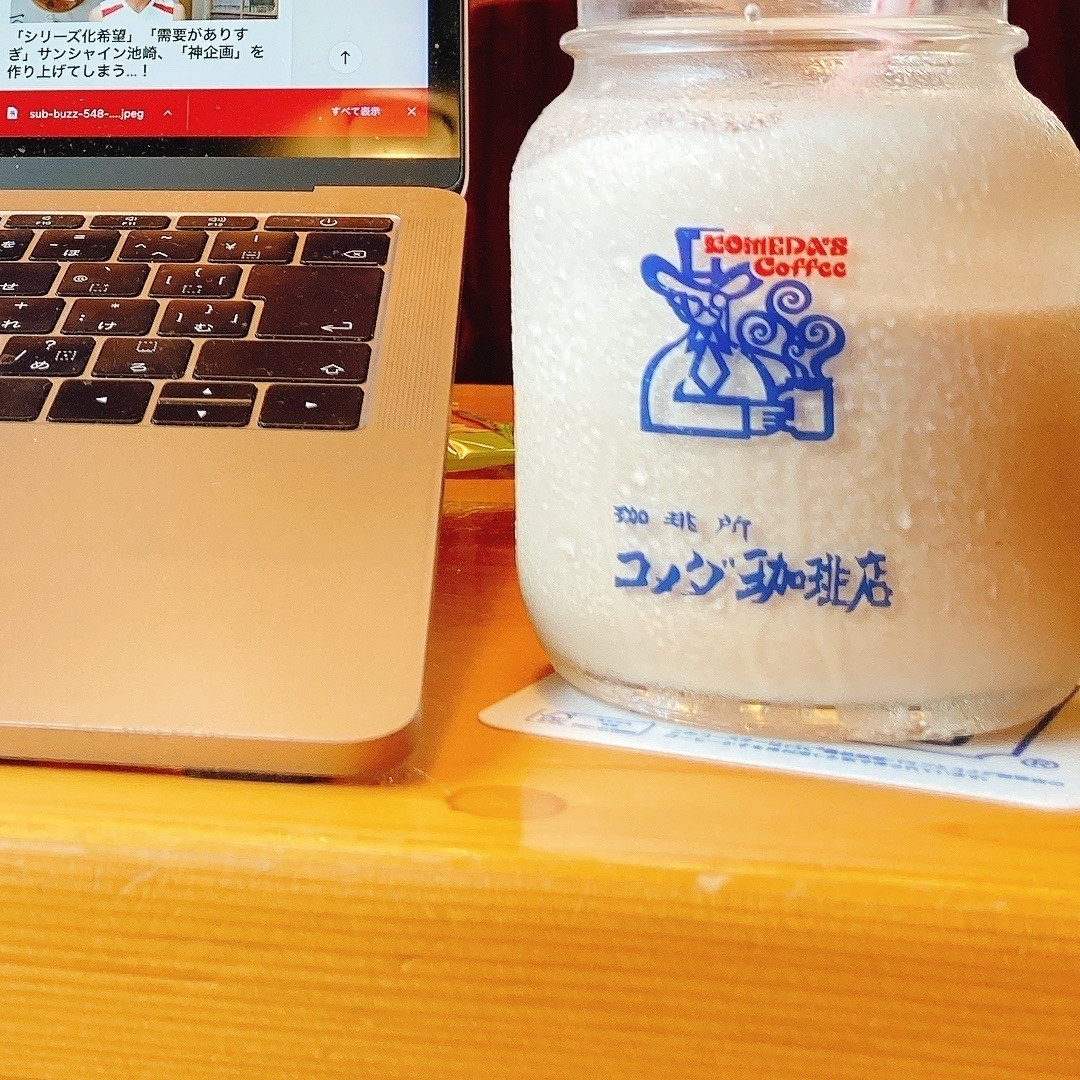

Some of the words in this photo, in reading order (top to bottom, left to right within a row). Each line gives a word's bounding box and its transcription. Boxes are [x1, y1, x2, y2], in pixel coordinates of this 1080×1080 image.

[16, 27, 249, 44] 「シリーズ化希望」「需要がありす
[9, 44, 265, 62] ぎ」サンシャイン池崎、「神企画」を
[330, 105, 381, 117] すべて表示
[704, 233, 848, 258] KOMEDA'S
[753, 257, 848, 279] Coffee
[614, 548, 894, 612] コメダ珈琲店
